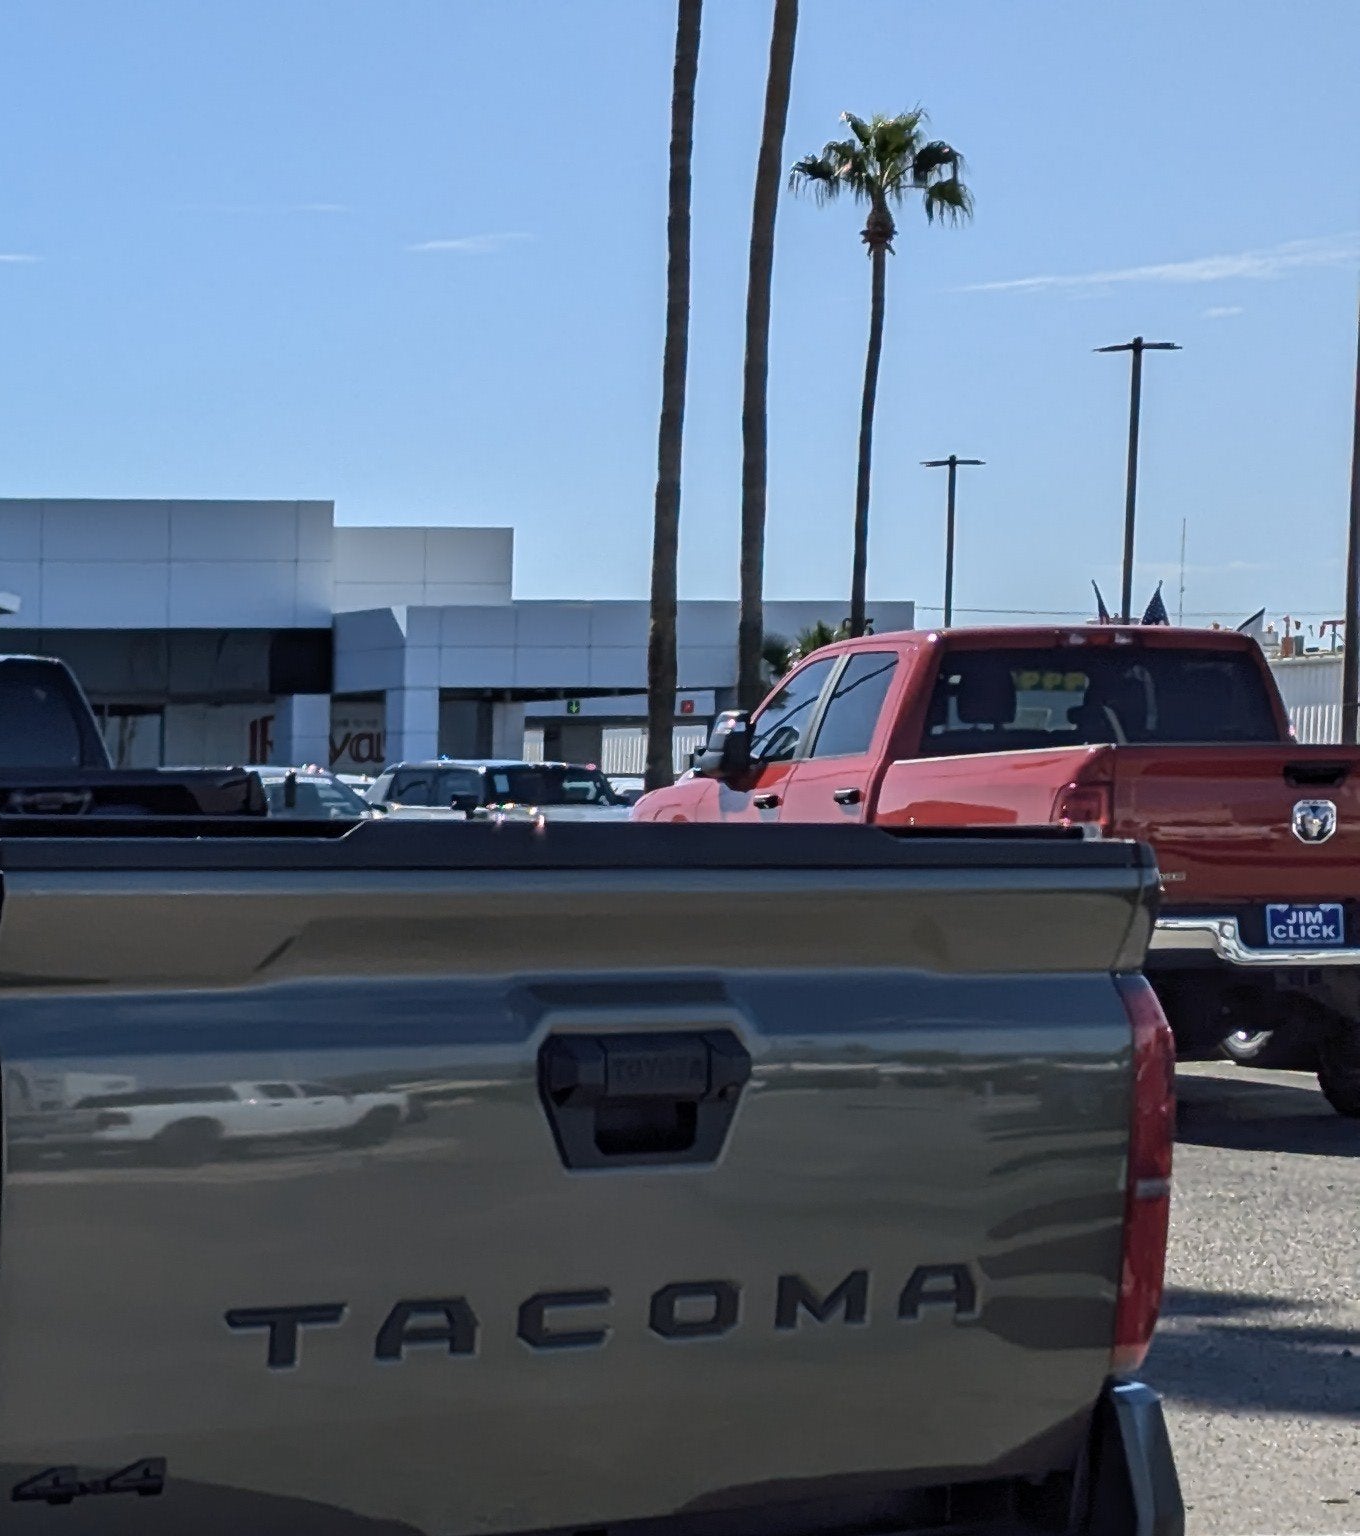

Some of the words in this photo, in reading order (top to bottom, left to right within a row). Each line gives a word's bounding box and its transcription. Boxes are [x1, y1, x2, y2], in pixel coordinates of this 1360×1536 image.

[1286, 911, 1323, 924] JIM
[1273, 924, 1336, 938] CLICK
[224, 1262, 980, 1368] TACOMA
